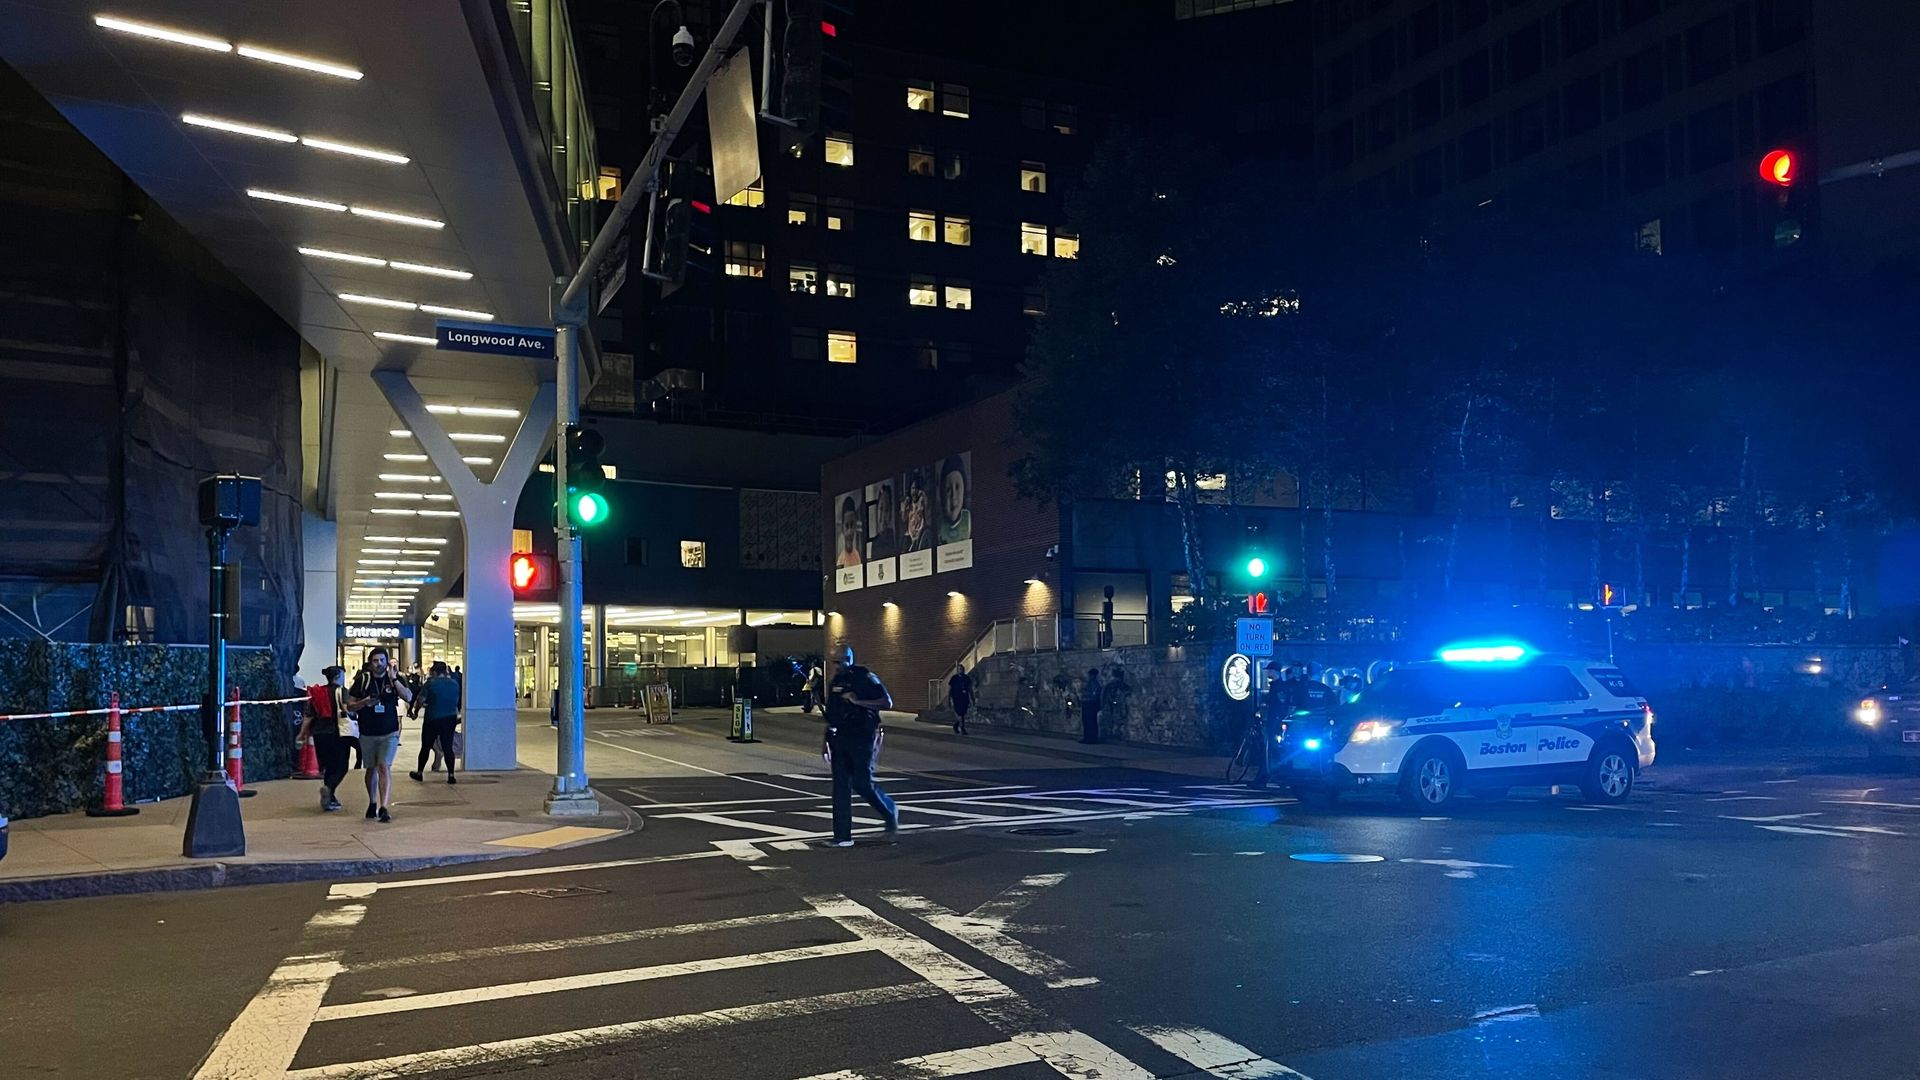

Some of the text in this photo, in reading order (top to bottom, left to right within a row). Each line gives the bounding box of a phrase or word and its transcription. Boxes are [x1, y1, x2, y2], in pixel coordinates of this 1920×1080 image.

[448, 331, 545, 349] Longwood Ave.
[1249, 623, 1261, 631] NO
[345, 625, 400, 638] Entrance
[1246, 633, 1265, 641] TURN
[1240, 643, 1270, 651] ON RED
[650, 686, 667, 694] STOP
[1480, 736, 1580, 756] Boston Police
